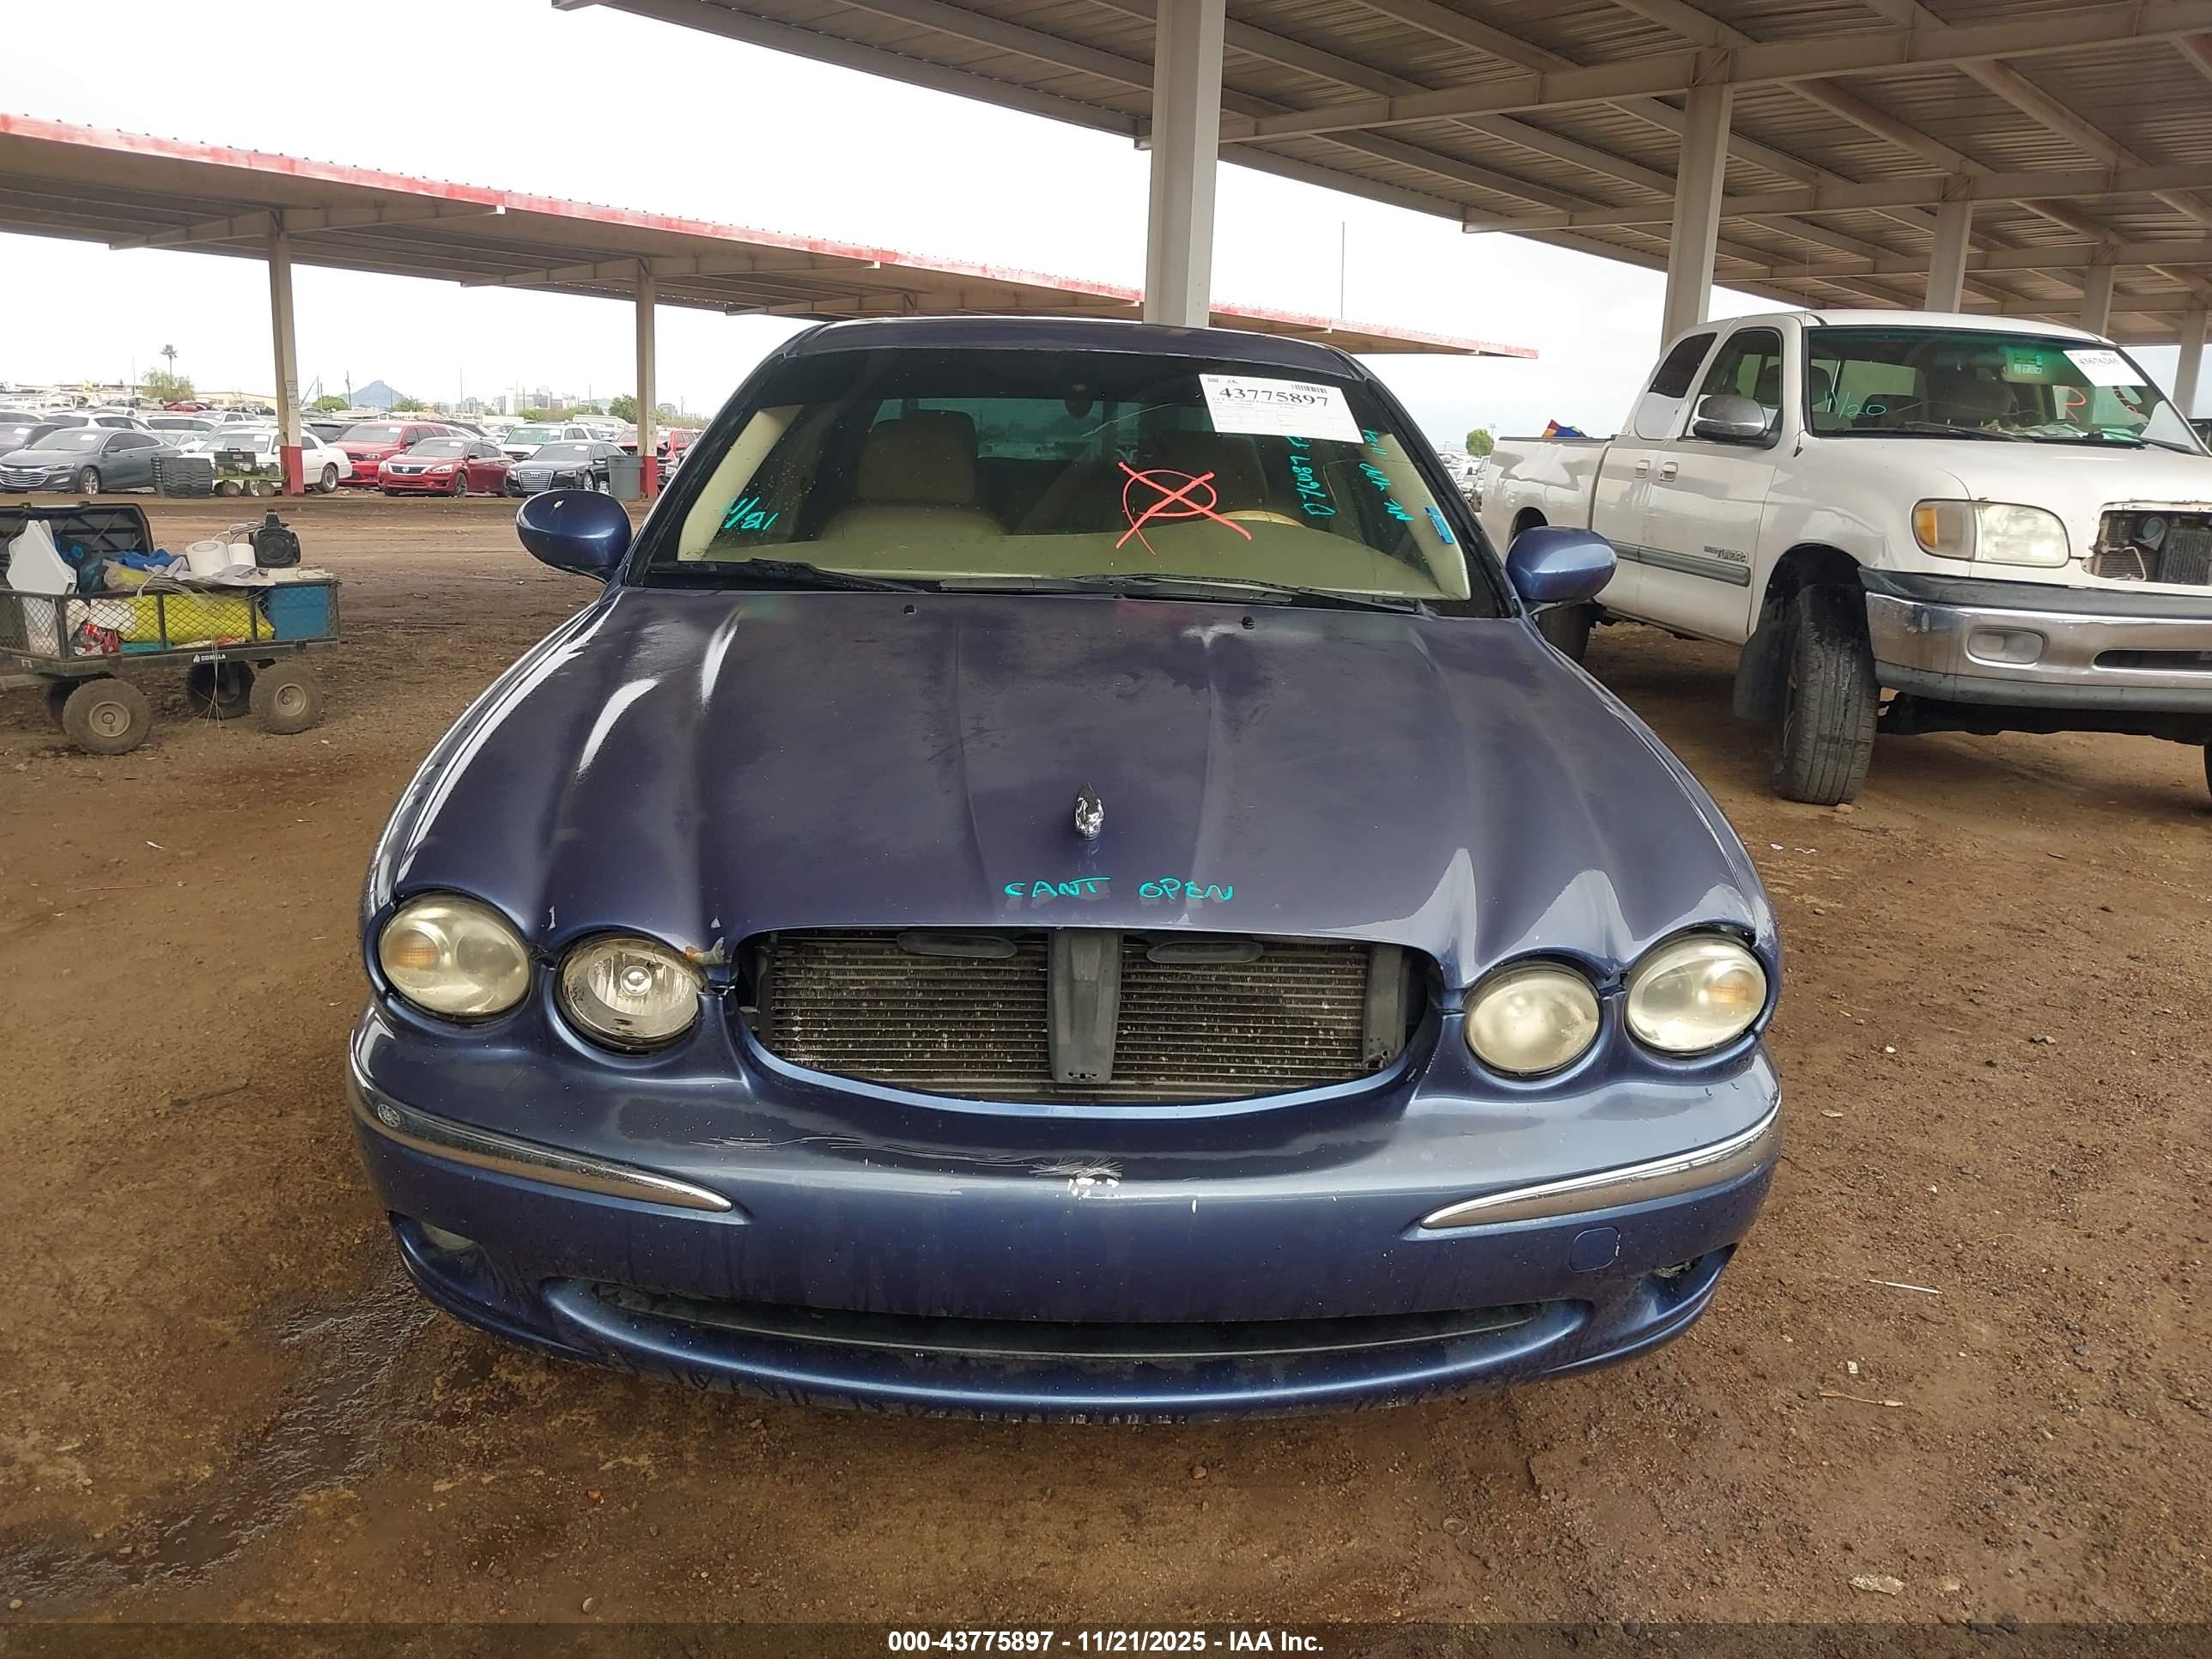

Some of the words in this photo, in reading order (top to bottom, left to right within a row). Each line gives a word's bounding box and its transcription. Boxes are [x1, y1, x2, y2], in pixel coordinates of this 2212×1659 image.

[1218, 387, 1328, 407] 43775897
[1003, 877, 1111, 898] CANT
[1138, 877, 1234, 901] OPEN
